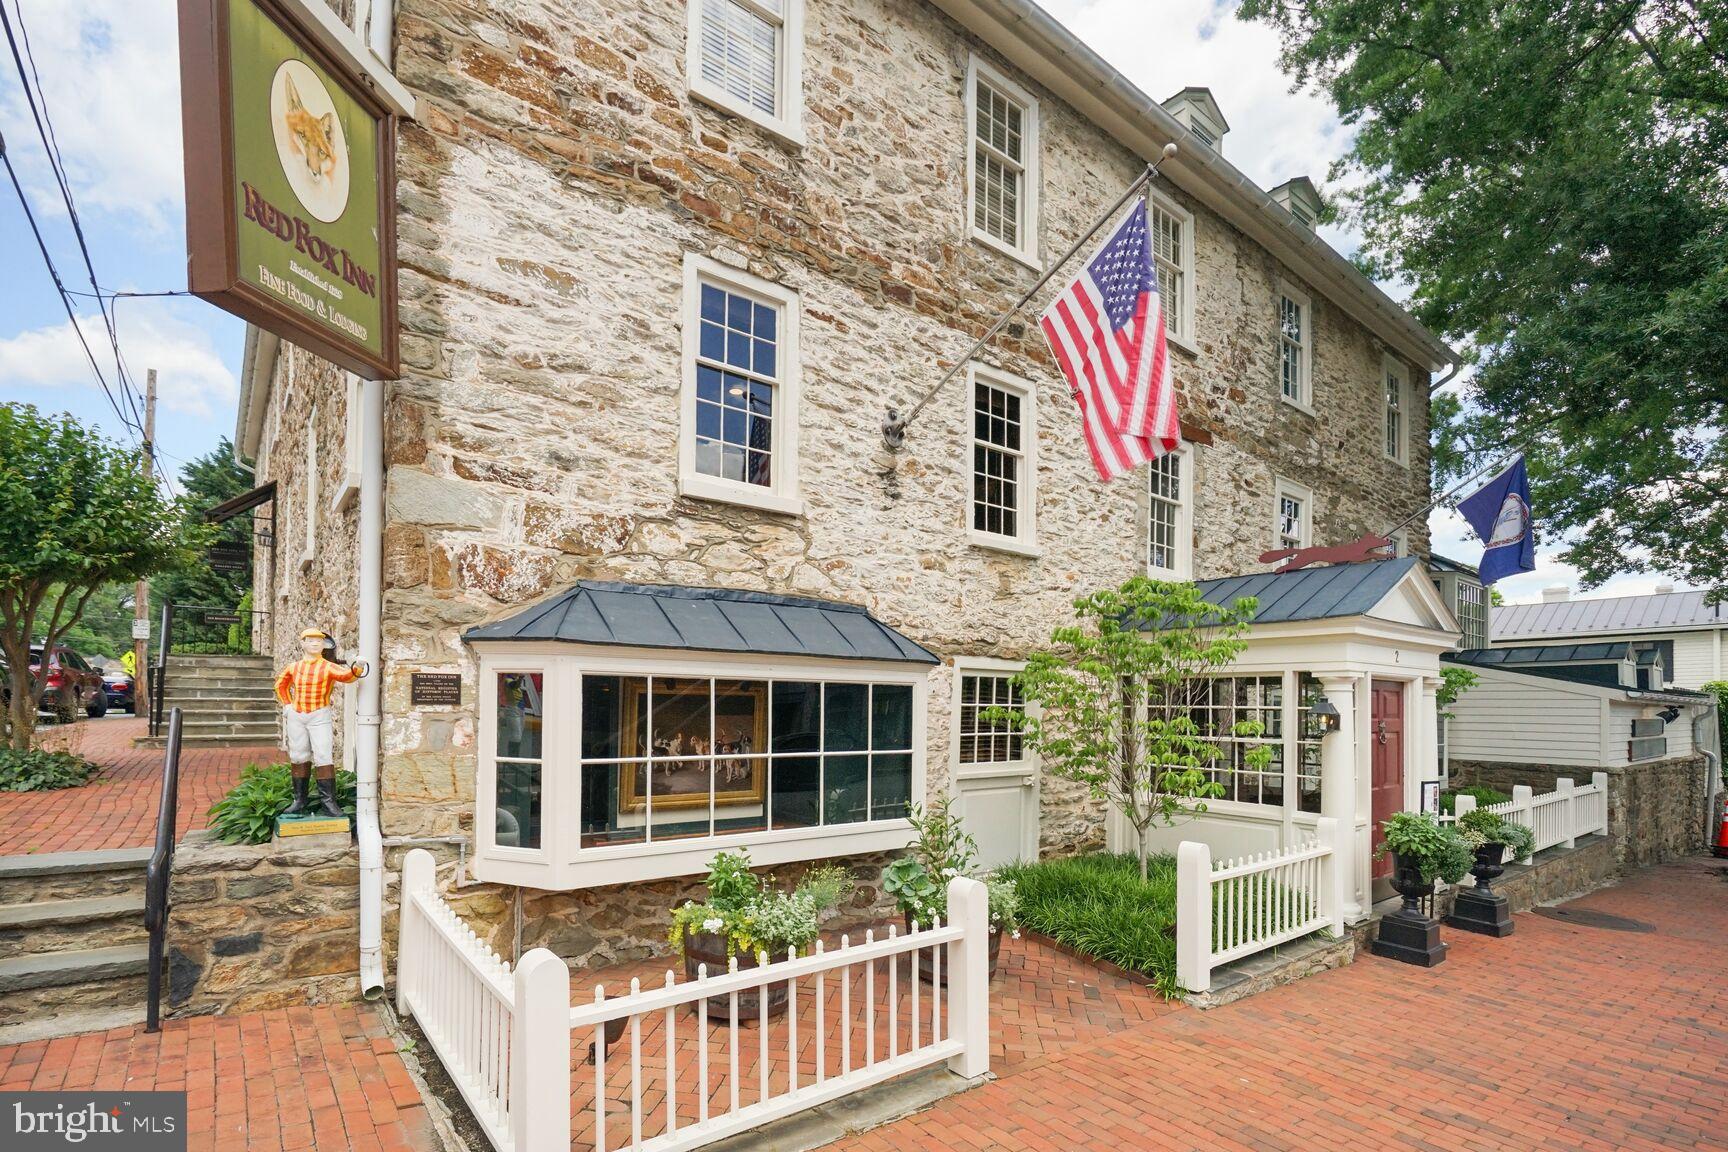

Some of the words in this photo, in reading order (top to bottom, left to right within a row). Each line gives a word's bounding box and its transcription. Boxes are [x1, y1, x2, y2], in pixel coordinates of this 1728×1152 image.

[242, 181, 293, 242] RED
[293, 216, 340, 276] FOX
[341, 249, 376, 299] INN
[317, 300, 328, 319] &
[1394, 650, 1400, 663] 2
